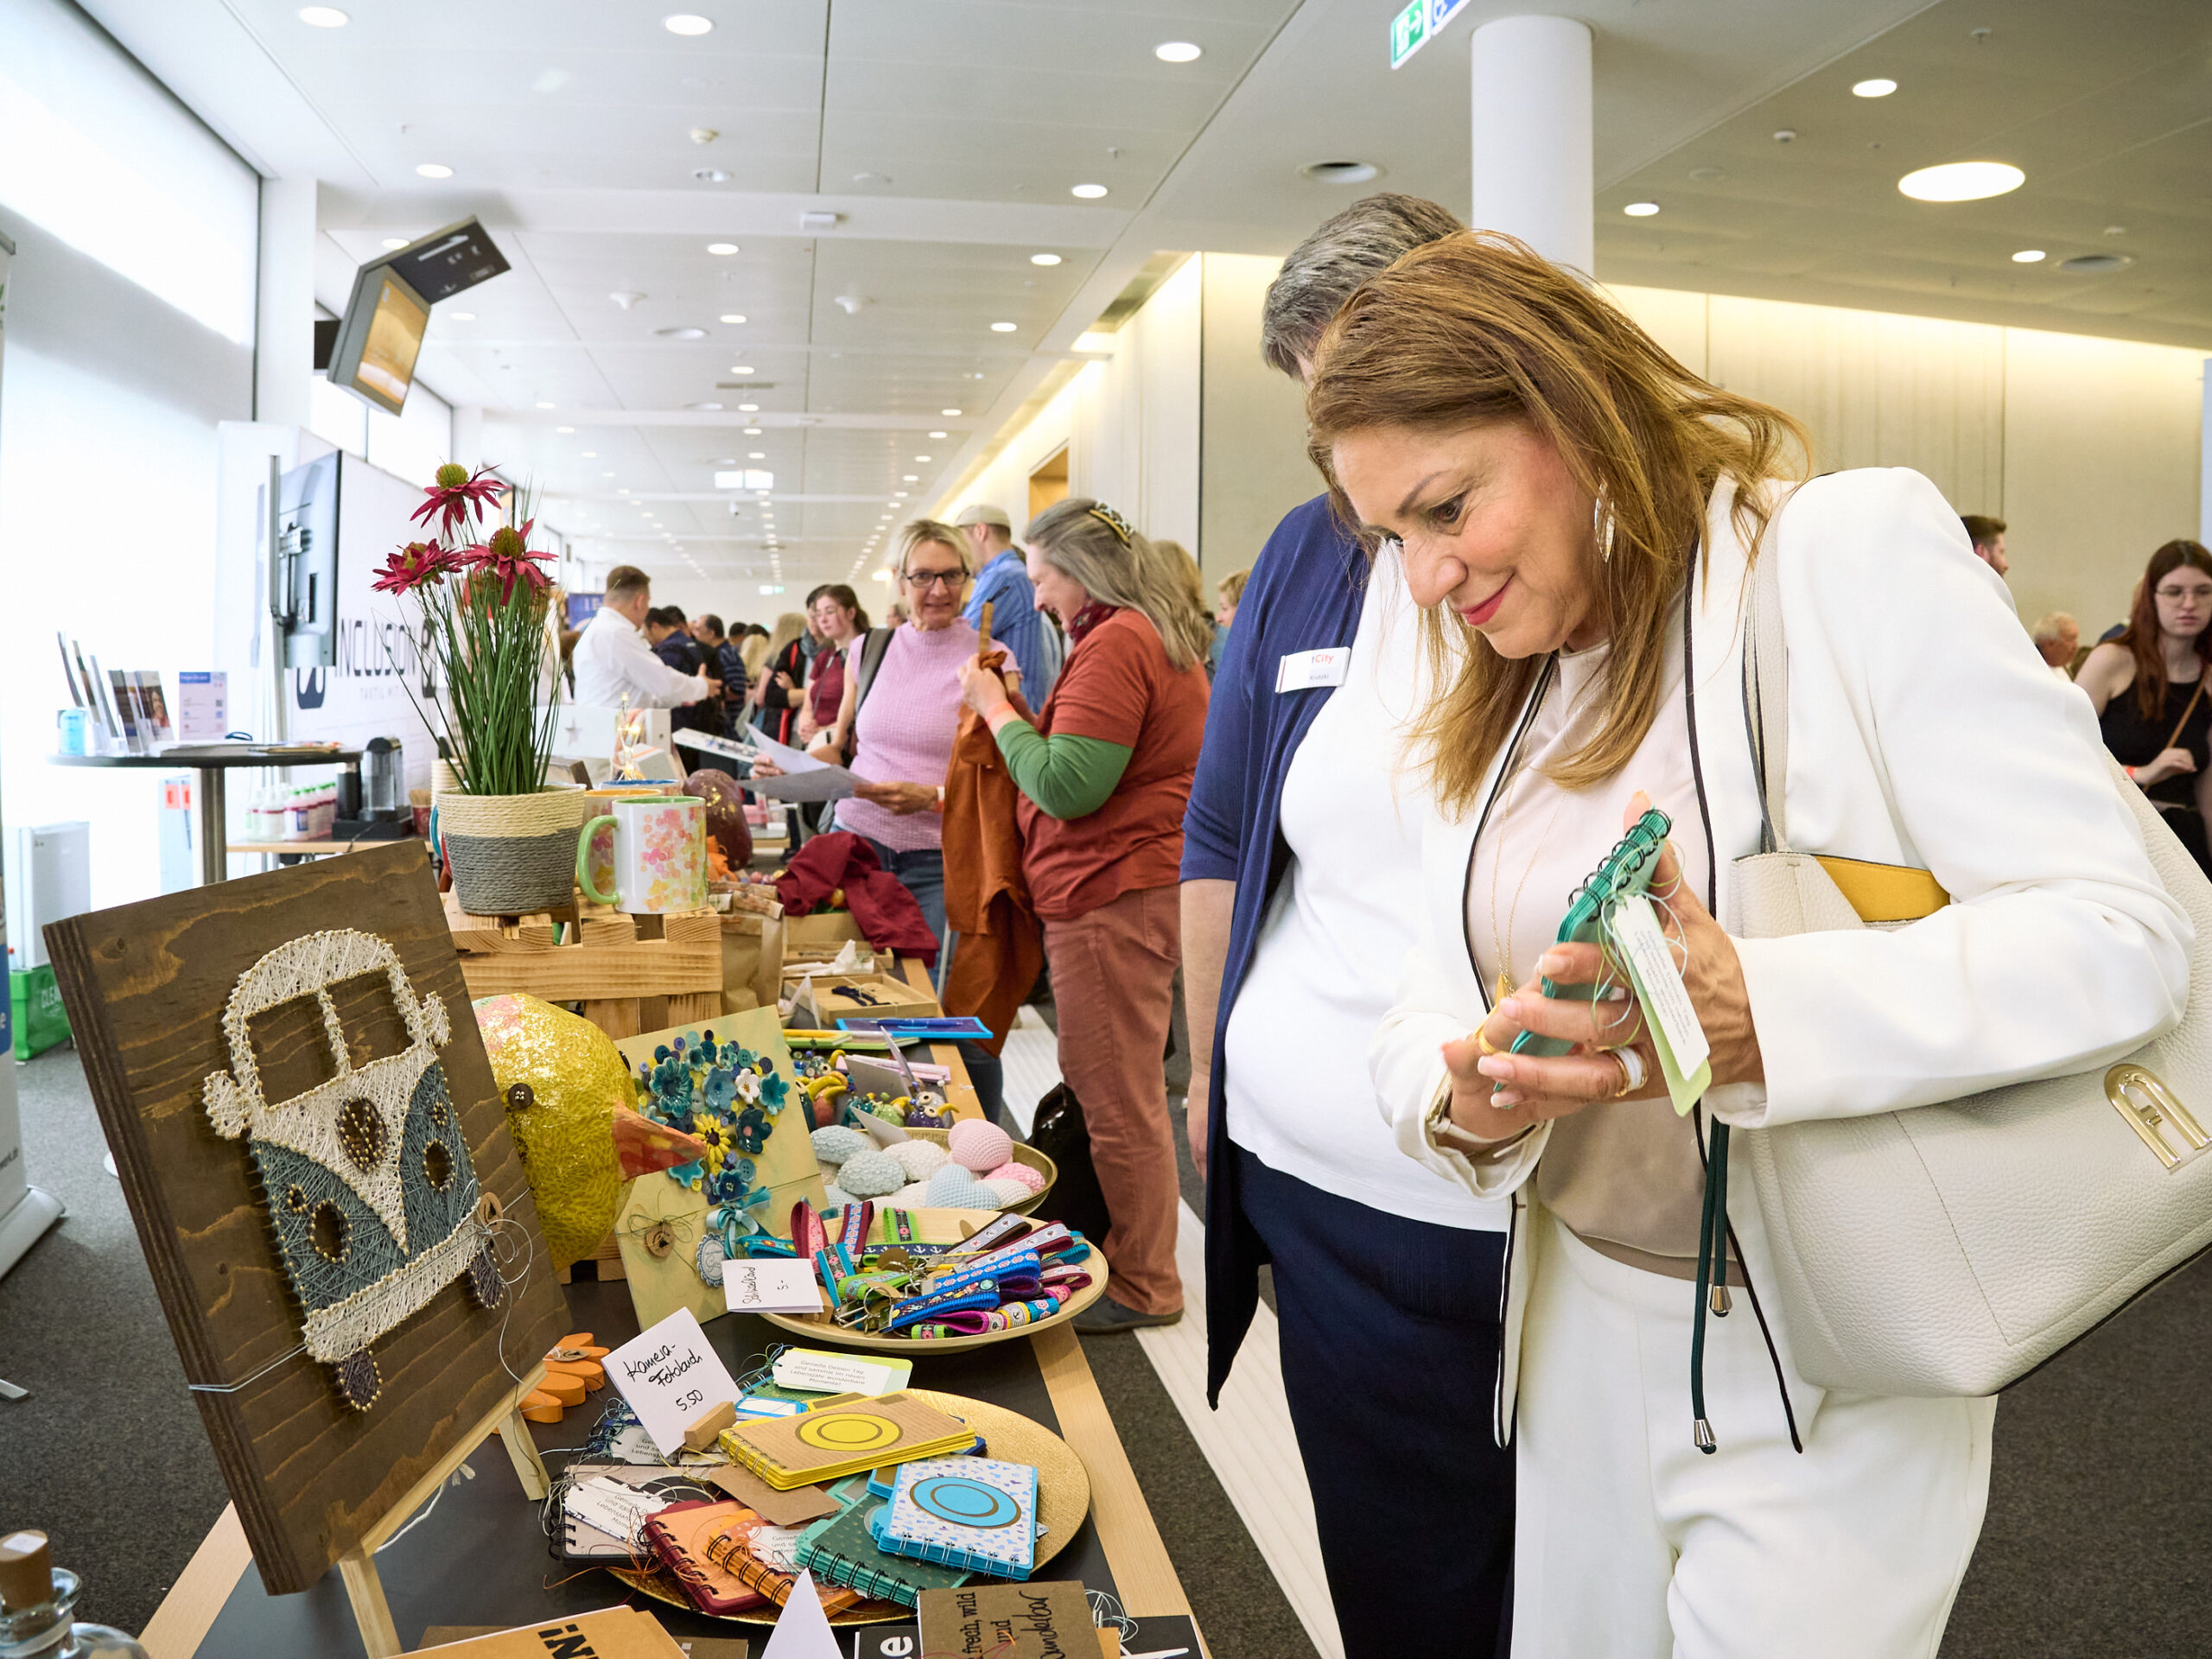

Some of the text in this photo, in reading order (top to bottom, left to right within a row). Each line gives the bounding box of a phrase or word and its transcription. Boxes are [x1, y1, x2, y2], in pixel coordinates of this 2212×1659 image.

[334, 618, 417, 677] NCLUSION
[648, 1348, 703, 1388] Fotobuch
[676, 1389, 703, 1411] 5.50
[956, 1592, 978, 1618] wild
[960, 1619, 982, 1655] frech,
[990, 1619, 1014, 1643] und
